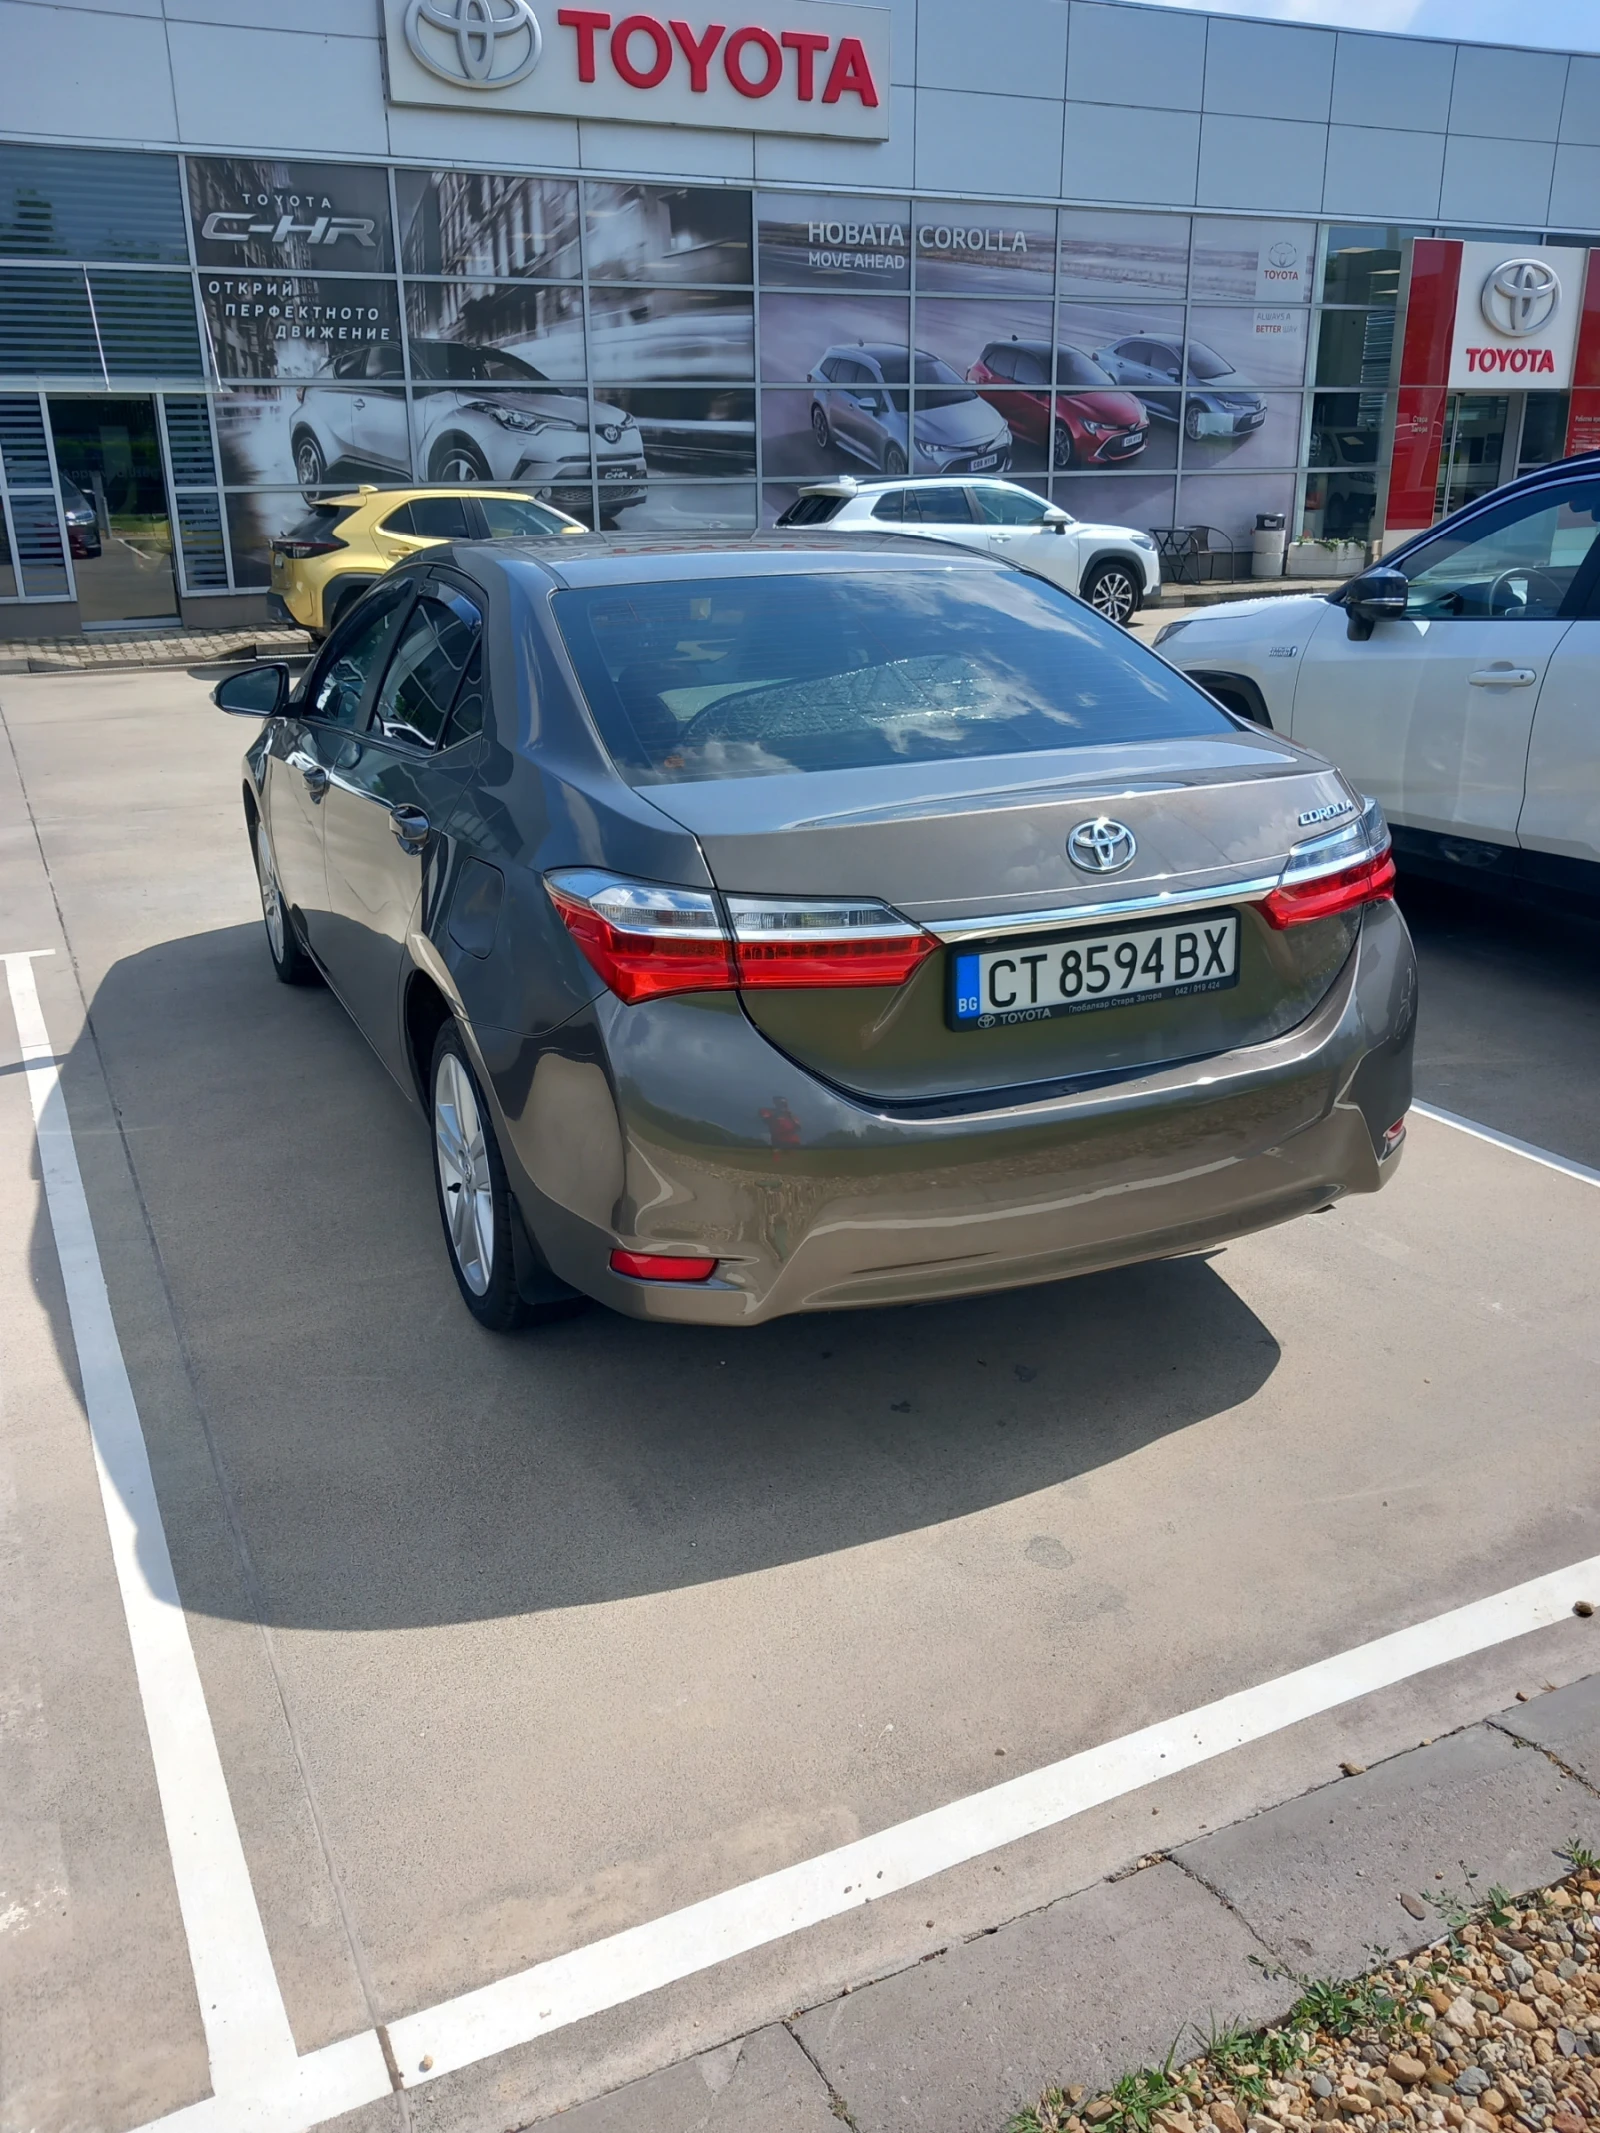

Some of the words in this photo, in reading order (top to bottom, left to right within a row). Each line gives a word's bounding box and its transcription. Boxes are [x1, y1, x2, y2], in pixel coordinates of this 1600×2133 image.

[557, 9, 879, 108] TOYOTA
[242, 193, 332, 209] TOYOTA
[201, 211, 377, 247] C-HR
[808, 221, 905, 247] НОВАТА
[918, 225, 1028, 252] COROLLA
[808, 251, 851, 268] MOVE
[854, 253, 905, 270] AHEAD
[1264, 270, 1299, 280] TOYOTA
[208, 280, 294, 297] ОТКРИЙ
[225, 303, 379, 321] ПЕРФЕКТНОТО
[1256, 313, 1285, 321] ALWAYS
[275, 325, 391, 340] ДВИЖЕНИЕ
[1256, 325, 1282, 333] BETTER
[1466, 347, 1555, 373] TOYOTA
[1299, 799, 1354, 826] COROLLA
[988, 954, 1048, 1008] CT
[1059, 936, 1164, 998] 8594
[1174, 926, 1228, 981] BX
[1174, 986, 1189, 996] 042
[1207, 980, 1221, 990] 424
[958, 996, 978, 1013] BG
[1111, 997, 1135, 1007] Стара
[1136, 991, 1162, 1002] Загора
[1000, 1007, 1052, 1025] TOYOTA
